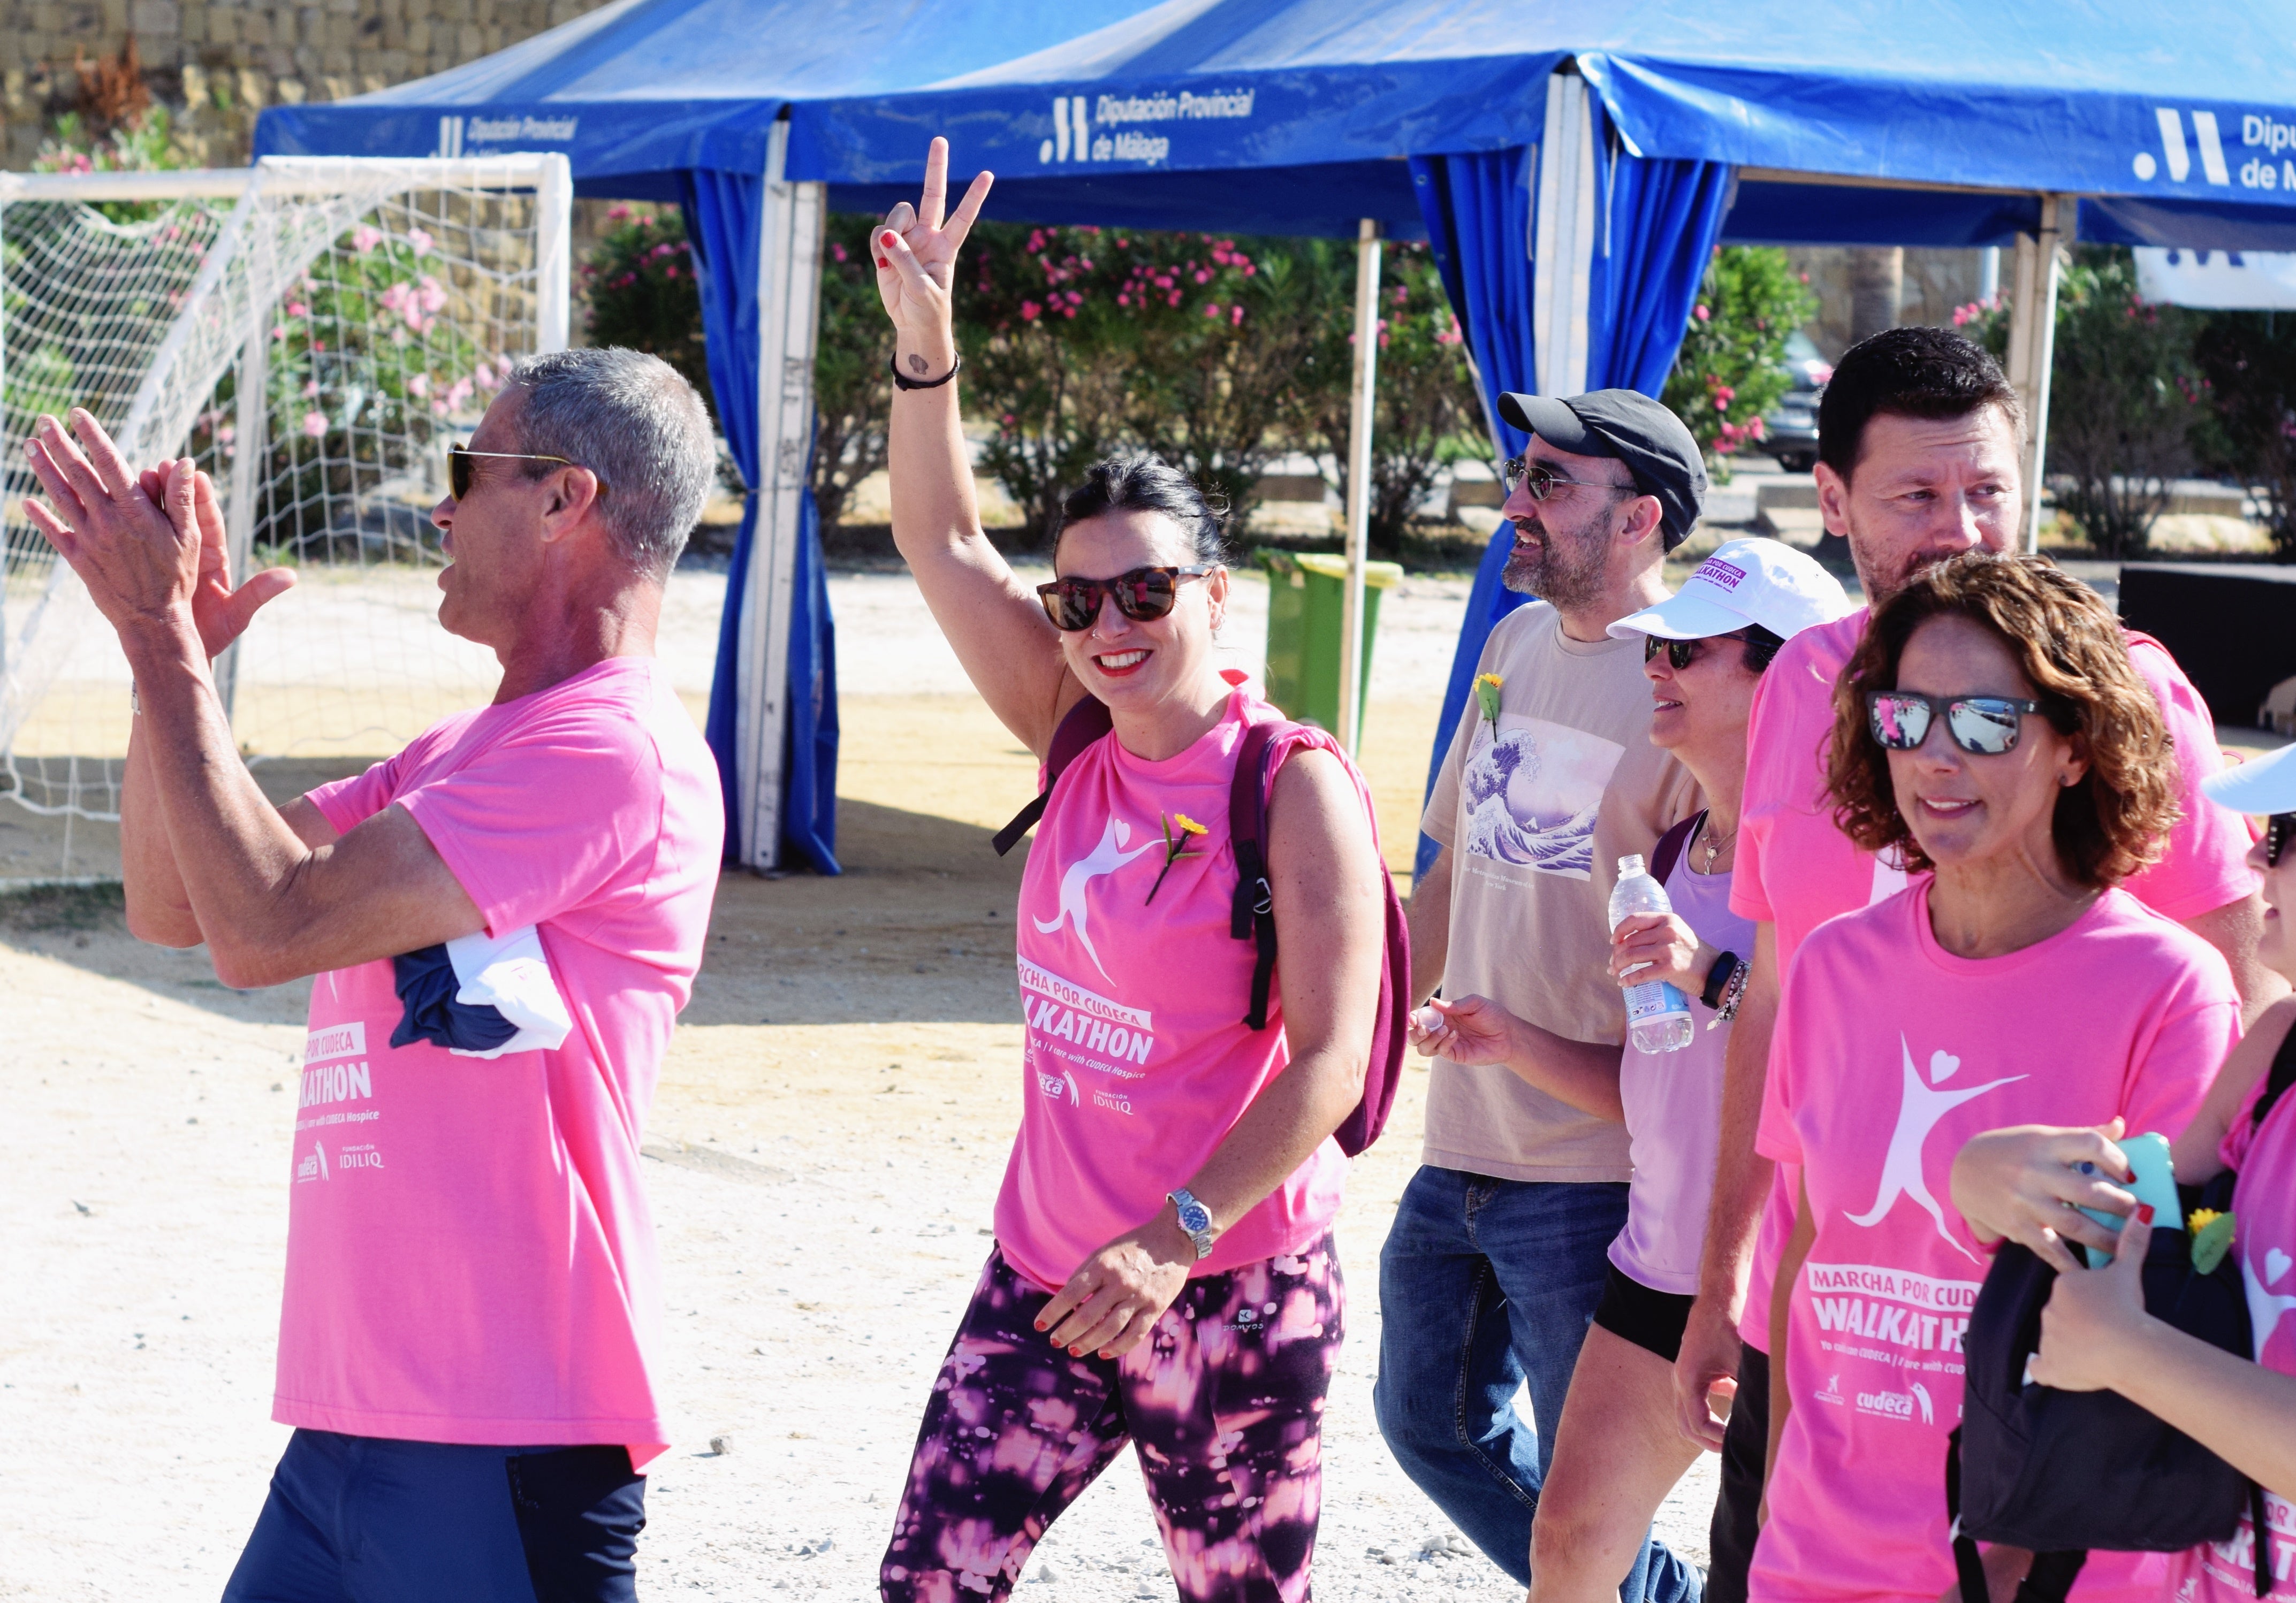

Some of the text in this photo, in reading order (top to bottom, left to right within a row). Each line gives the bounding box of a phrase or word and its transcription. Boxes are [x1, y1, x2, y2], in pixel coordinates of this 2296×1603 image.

[1176, 87, 1255, 119] Provincial
[1092, 133, 1113, 161] de
[2240, 157, 2277, 190] de
[1053, 981, 1081, 1006] POR
[1084, 997, 1142, 1027] CUDECA
[321, 1030, 354, 1056] CUDECA
[1053, 1048, 1067, 1058] care
[1068, 1053, 1085, 1065] with
[1086, 1058, 1111, 1073] CUDECA
[1111, 1066, 1146, 1080] Hospice
[346, 1109, 380, 1124] Hospice
[1093, 1094, 1134, 1116] IDILIQ
[339, 1151, 385, 1169] IDILIQ
[1814, 1270, 1895, 1295] MARCHA
[1902, 1278, 1929, 1303] POR
[1222, 1323, 1264, 1332] DOMYOS
[1856, 1390, 1914, 1416] cudeca
